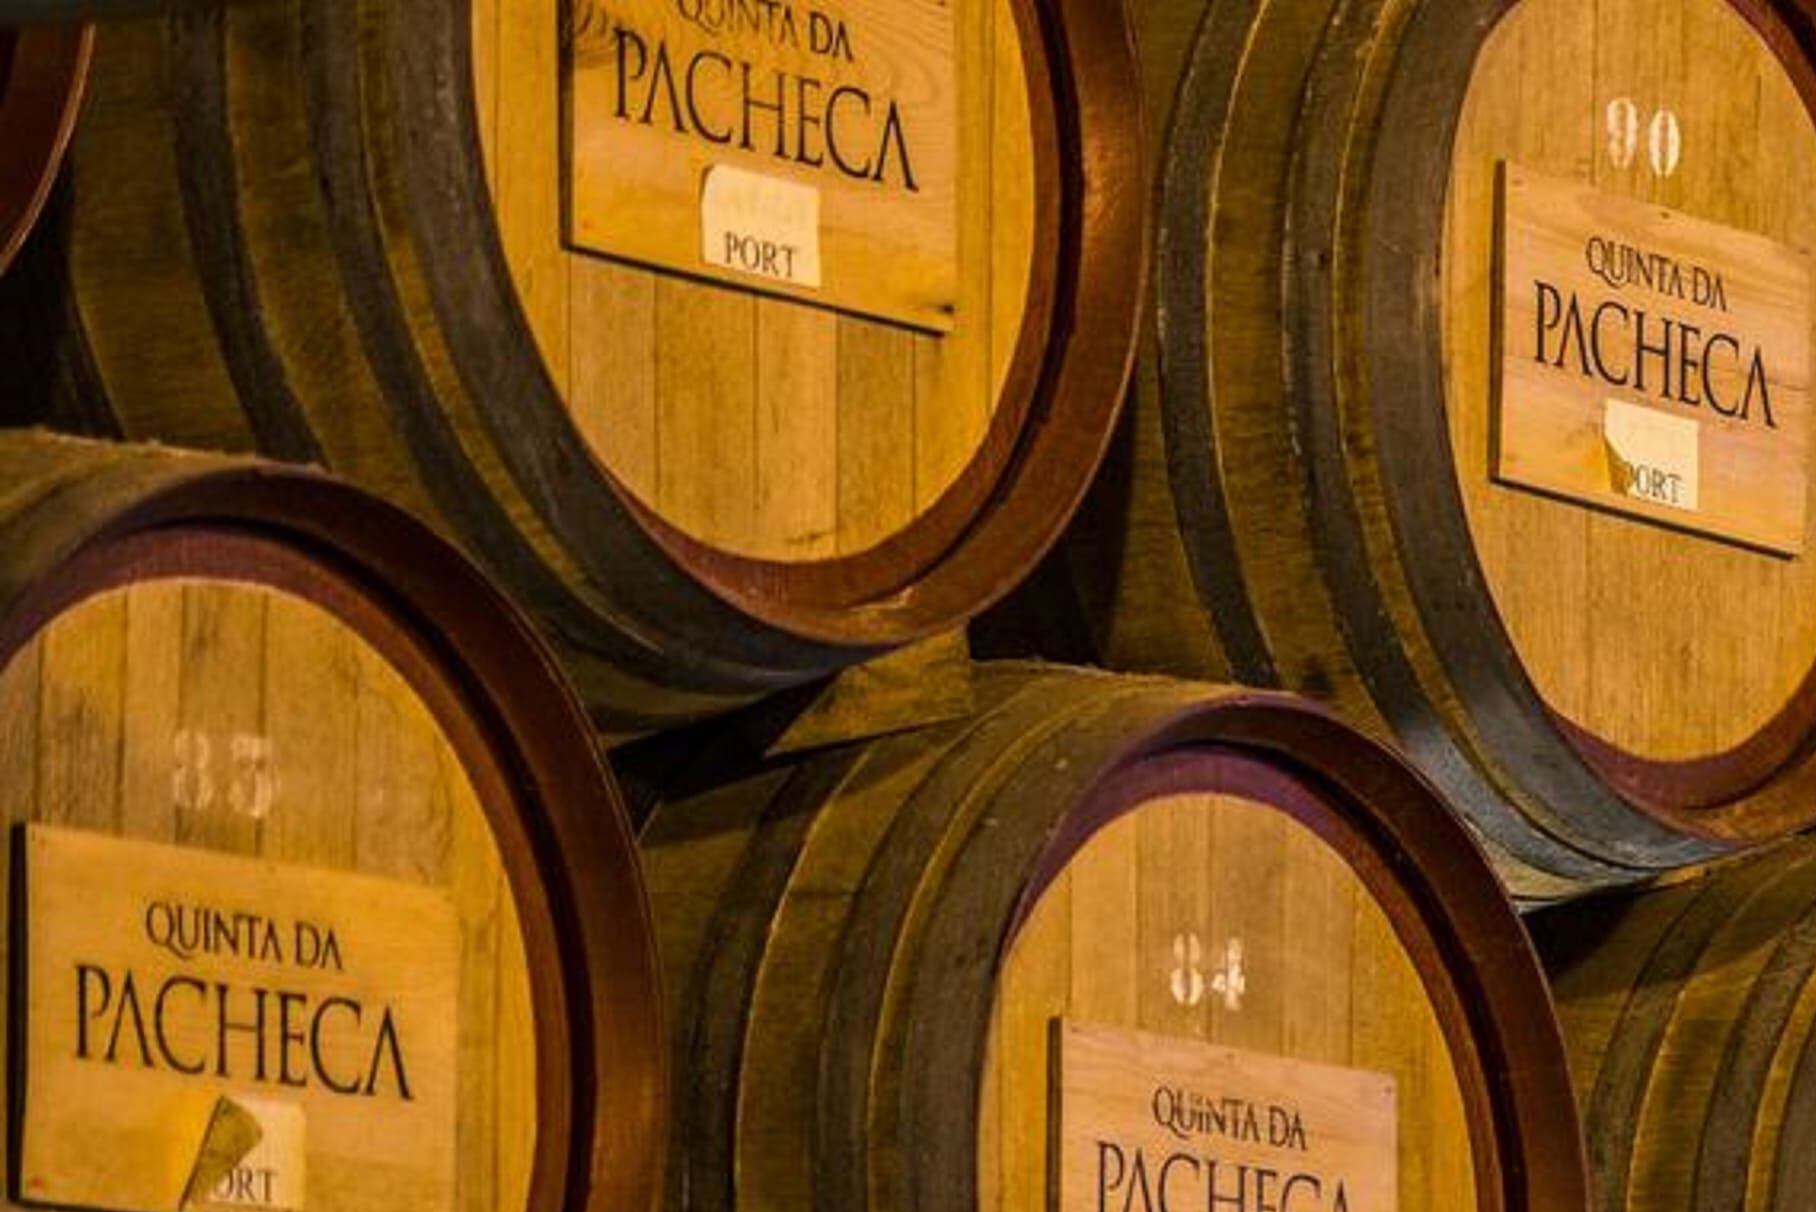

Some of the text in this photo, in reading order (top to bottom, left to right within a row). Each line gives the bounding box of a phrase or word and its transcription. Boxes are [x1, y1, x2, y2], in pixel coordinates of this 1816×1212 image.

[809, 11, 854, 63] DA
[613, 26, 920, 192] PACHECA
[1606, 97, 1681, 177] 90
[723, 231, 798, 279] PORT
[1585, 235, 1728, 312] QUINTA DA
[1533, 279, 1778, 429] PACHECA
[144, 900, 344, 971] QUINTA DA
[74, 962, 415, 1101] PACHECA
[1151, 1084, 1308, 1151] QUINTA DA
